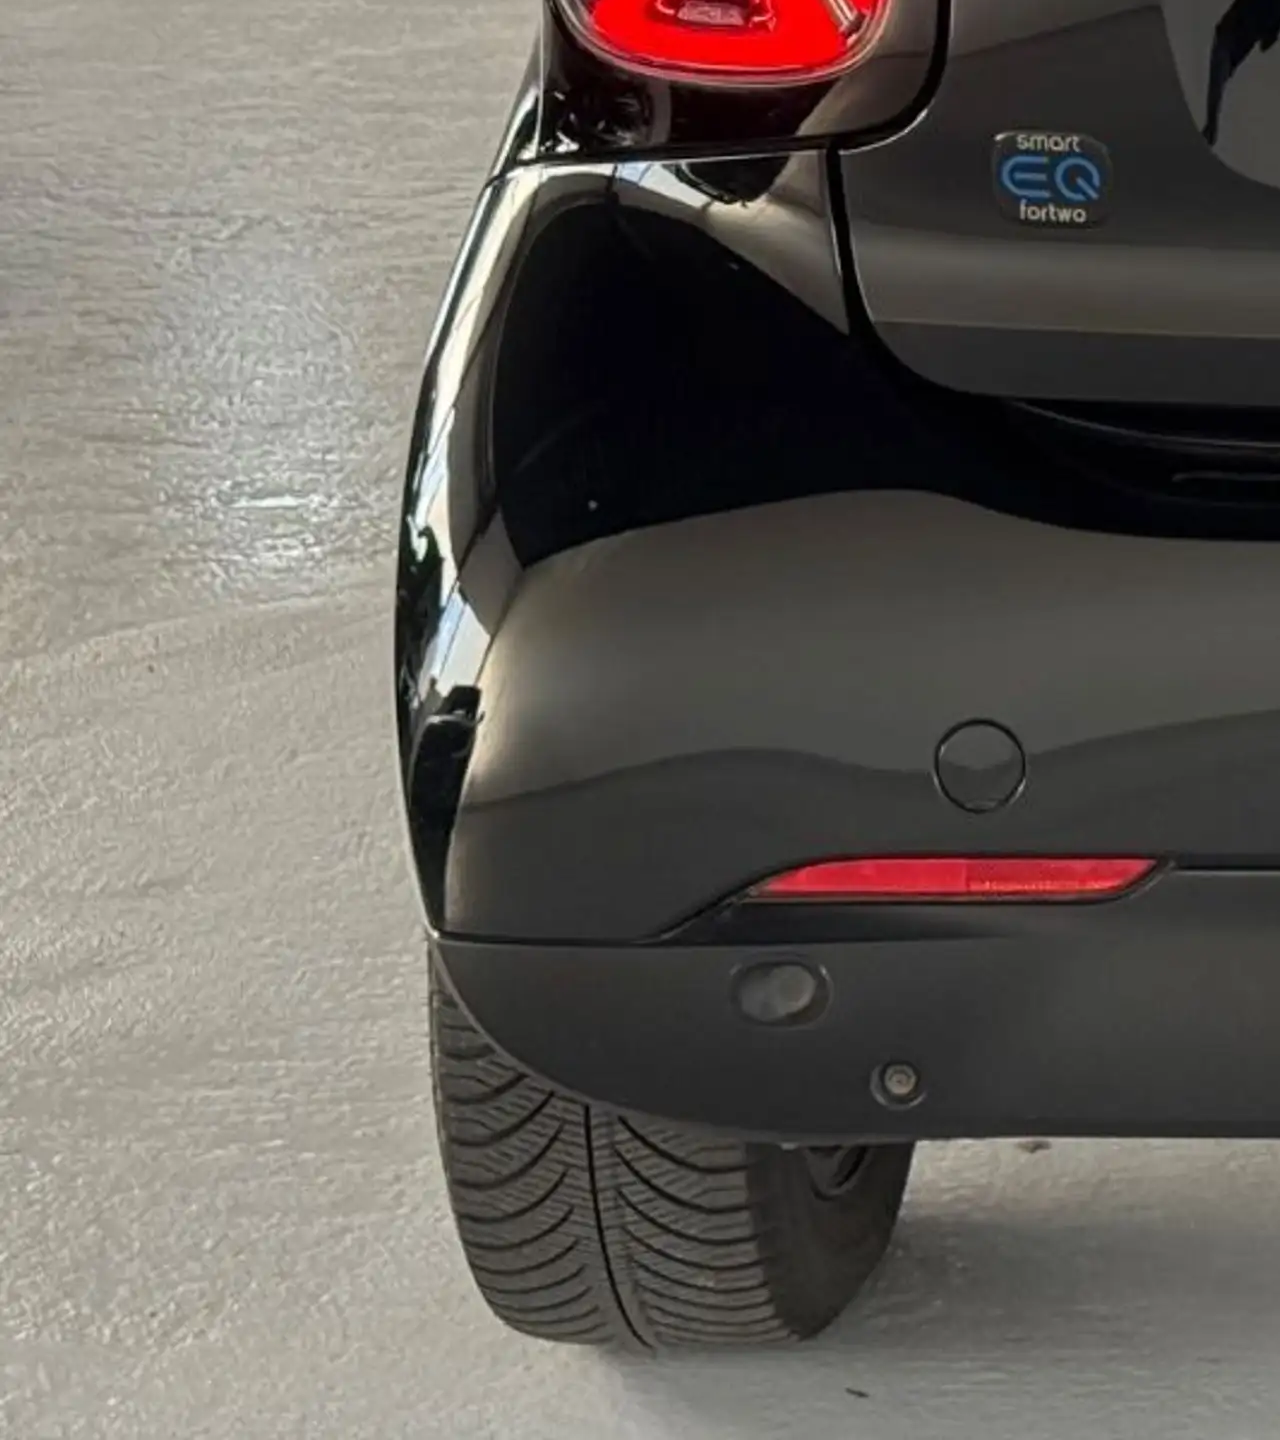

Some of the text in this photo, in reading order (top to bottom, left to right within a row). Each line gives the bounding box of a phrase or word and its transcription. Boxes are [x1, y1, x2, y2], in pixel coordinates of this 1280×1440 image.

[1016, 133, 1082, 153] smart
[1002, 155, 1101, 201] EQ
[1019, 197, 1087, 224] fortwo
